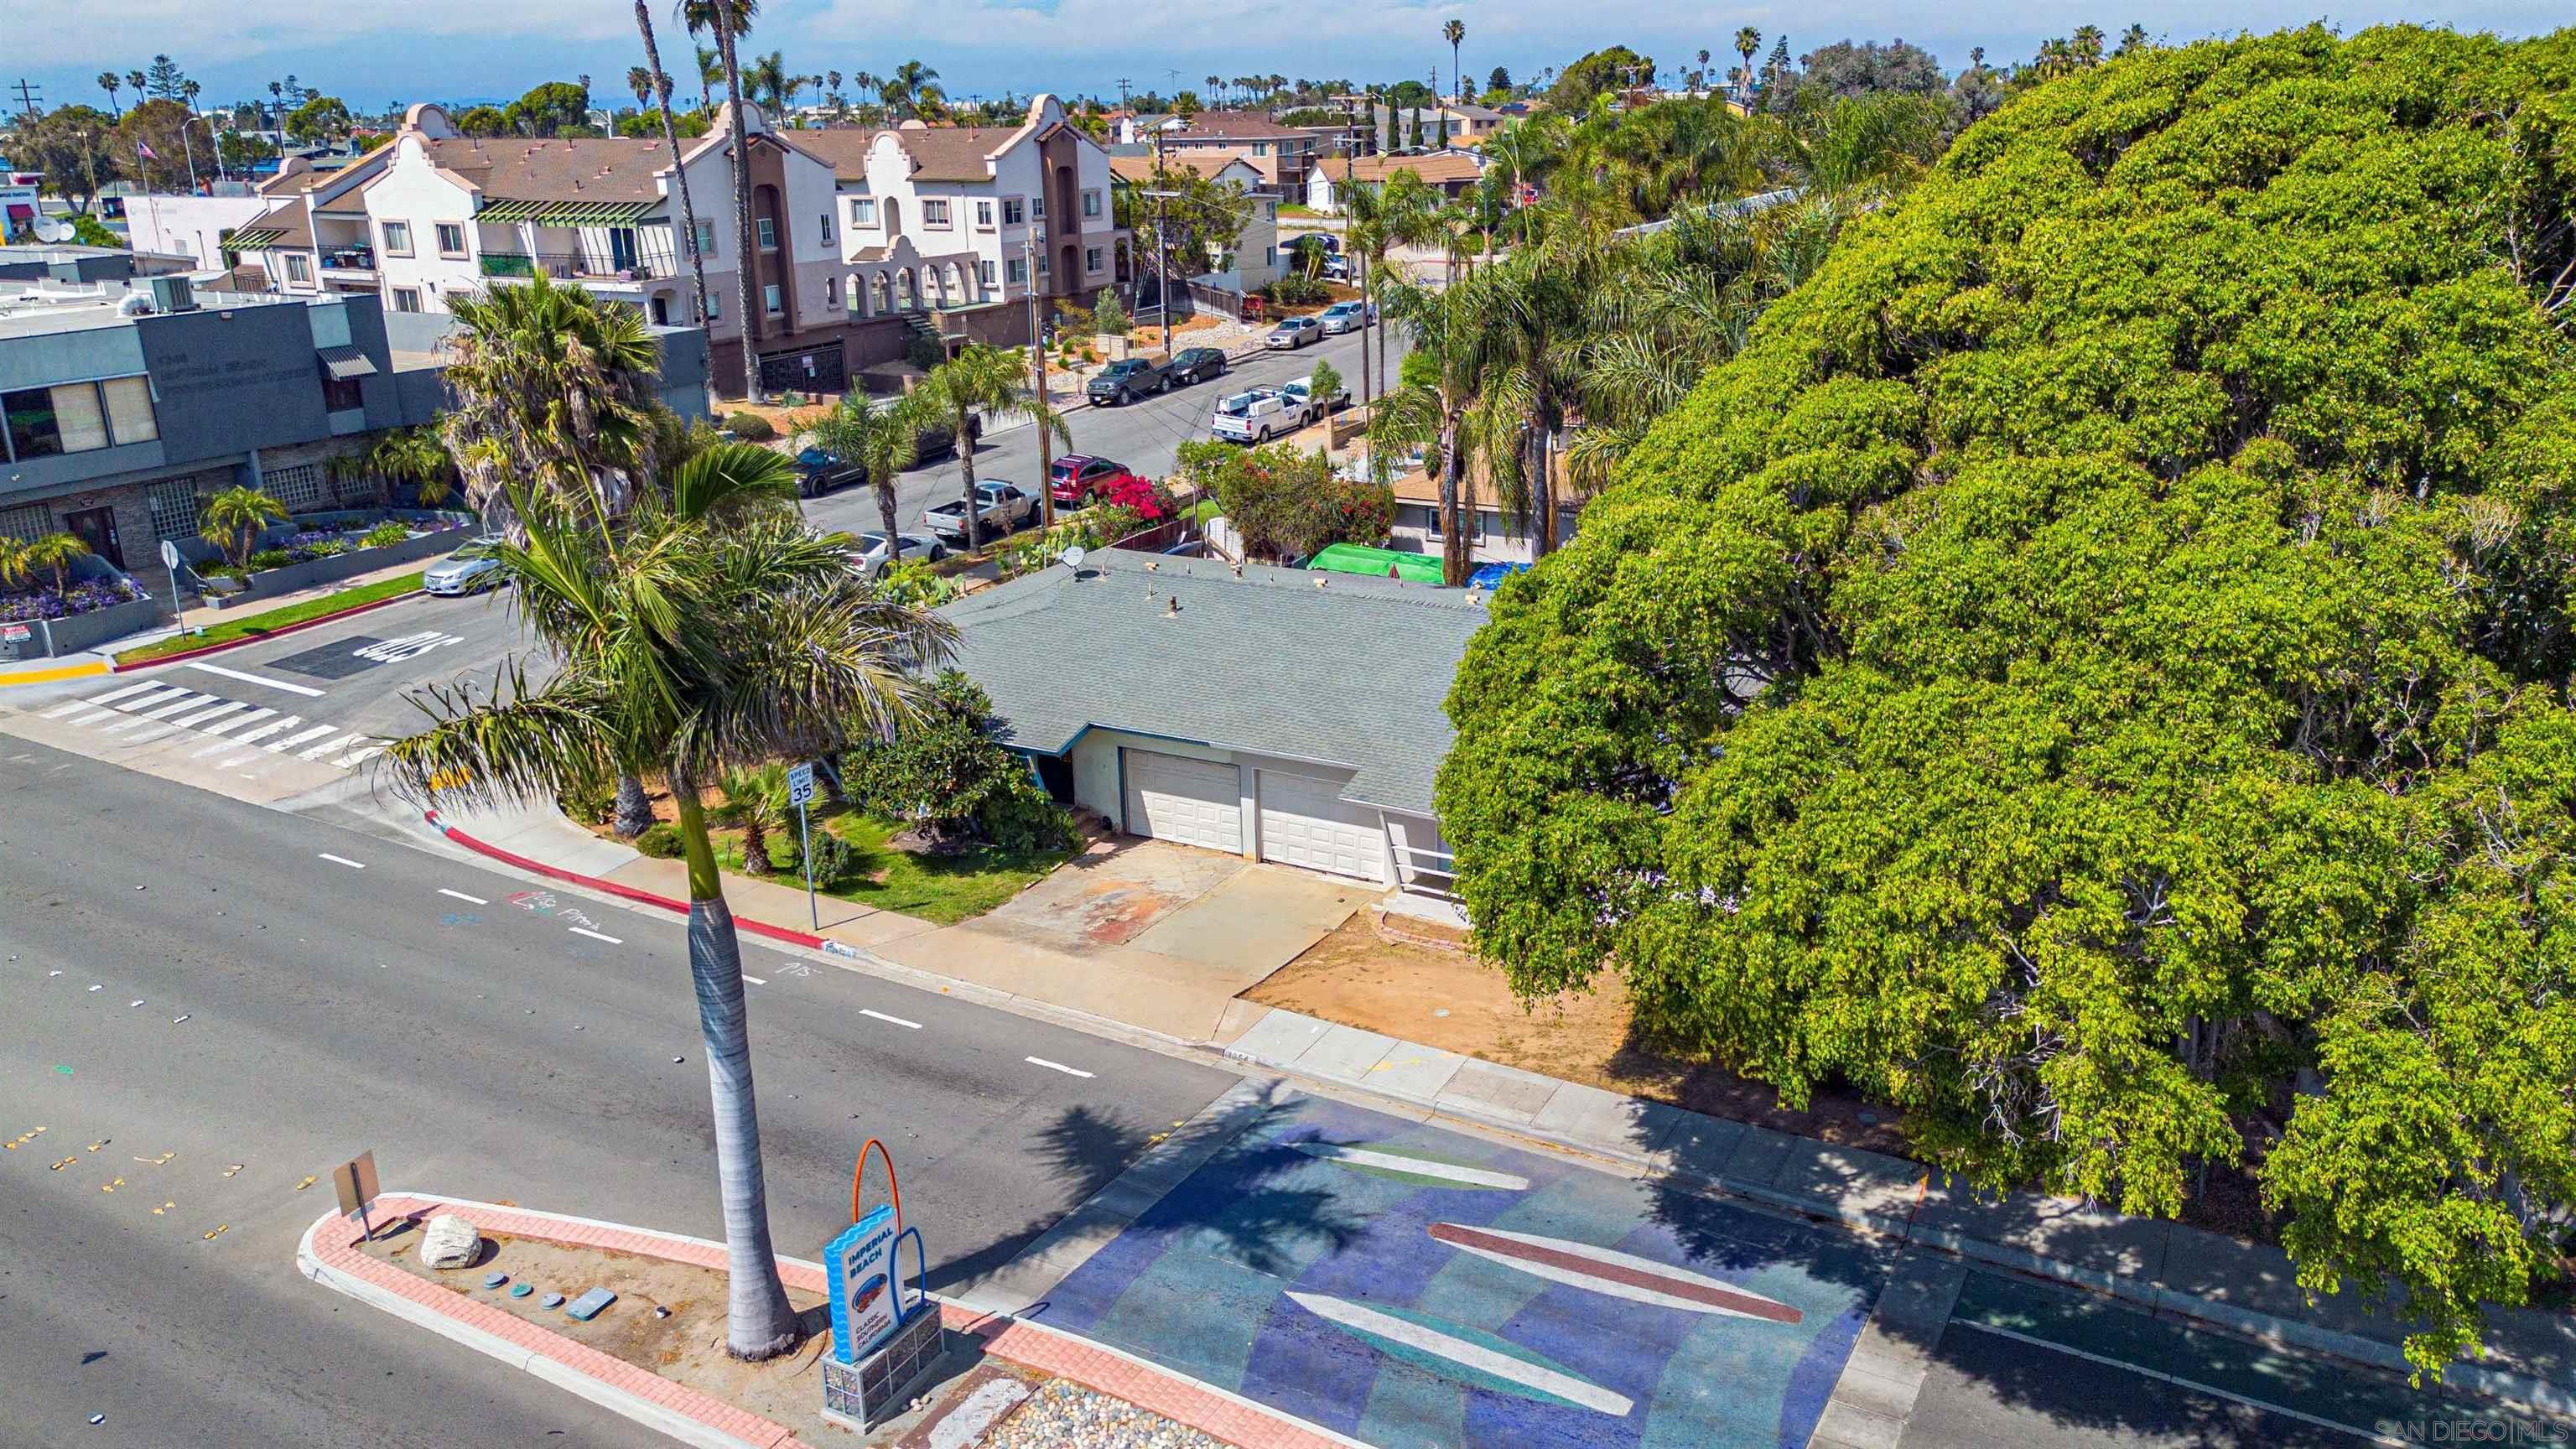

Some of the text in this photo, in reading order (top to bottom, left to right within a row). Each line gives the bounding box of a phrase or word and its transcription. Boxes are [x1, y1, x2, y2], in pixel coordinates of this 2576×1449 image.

[791, 767, 811, 780] SPEED
[793, 776, 809, 787] LIMIT
[793, 783, 812, 802] 35
[849, 1227, 894, 1265] IMPERIAL
[849, 1248, 882, 1279] BEACH
[856, 1311, 880, 1333] CLASSIC
[857, 1312, 887, 1342] SOUTHERN
[858, 1319, 891, 1349] CALIFORNIA
